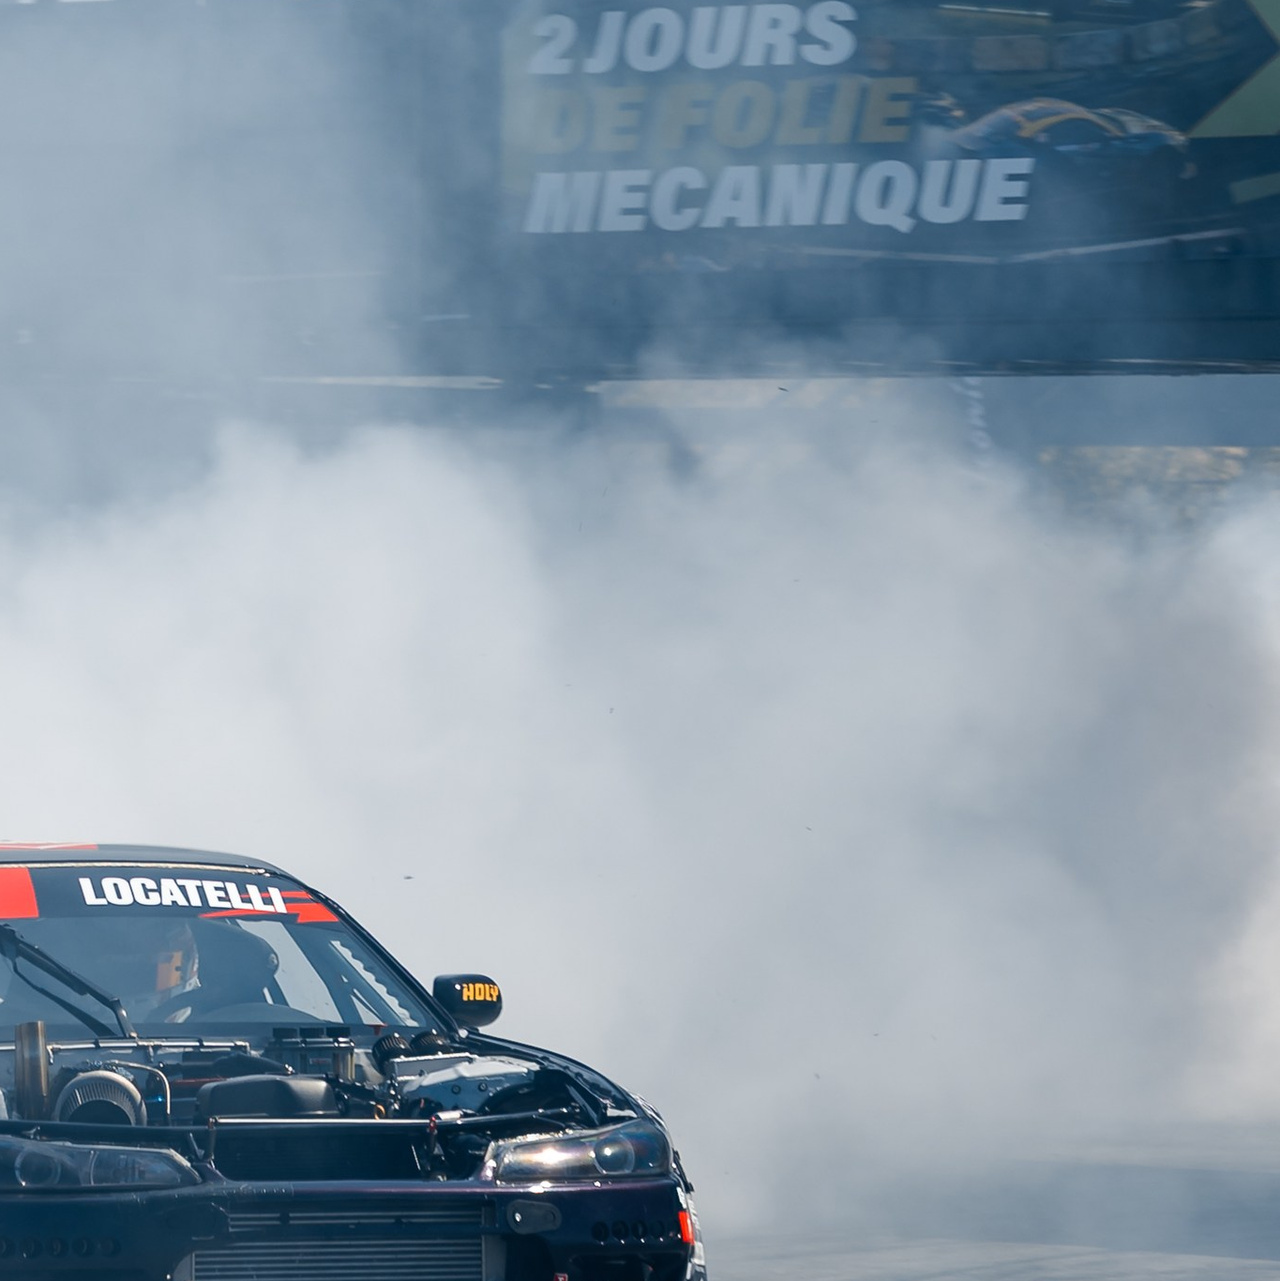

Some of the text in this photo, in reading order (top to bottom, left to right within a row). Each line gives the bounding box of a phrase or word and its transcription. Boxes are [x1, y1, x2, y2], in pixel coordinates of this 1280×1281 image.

[529, 1, 858, 75] 2 JOURS
[531, 77, 917, 155] DE FOLIE
[524, 157, 1035, 234] MECANIQUE
[78, 877, 288, 914] LOCATELLI
[462, 983, 499, 1002] HOLY
